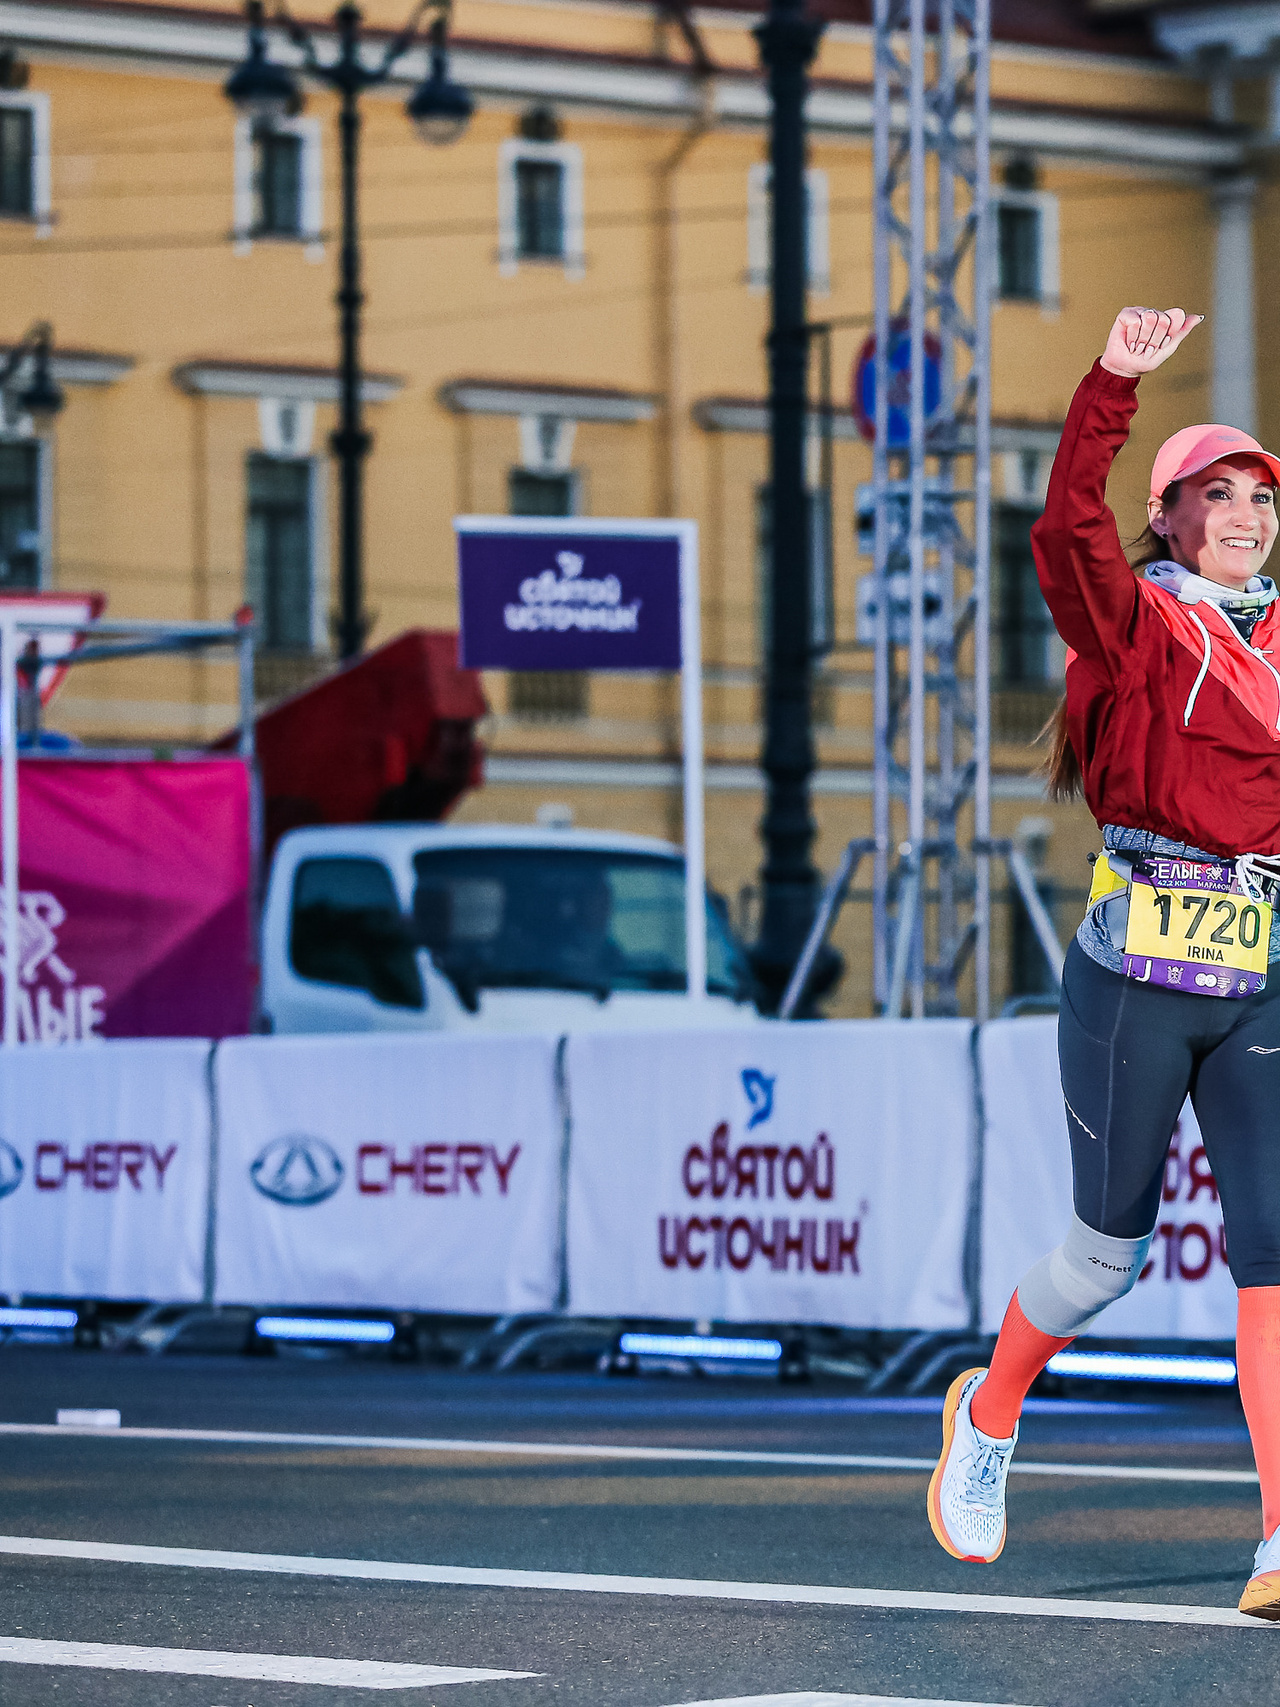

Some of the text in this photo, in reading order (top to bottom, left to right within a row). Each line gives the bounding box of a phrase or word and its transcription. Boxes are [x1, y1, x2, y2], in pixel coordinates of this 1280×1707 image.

[1153, 894, 1261, 949] 1720
[1187, 944, 1225, 962] IRINA
[33, 1141, 178, 1191] CHERY
[356, 1142, 522, 1196] CHERY
